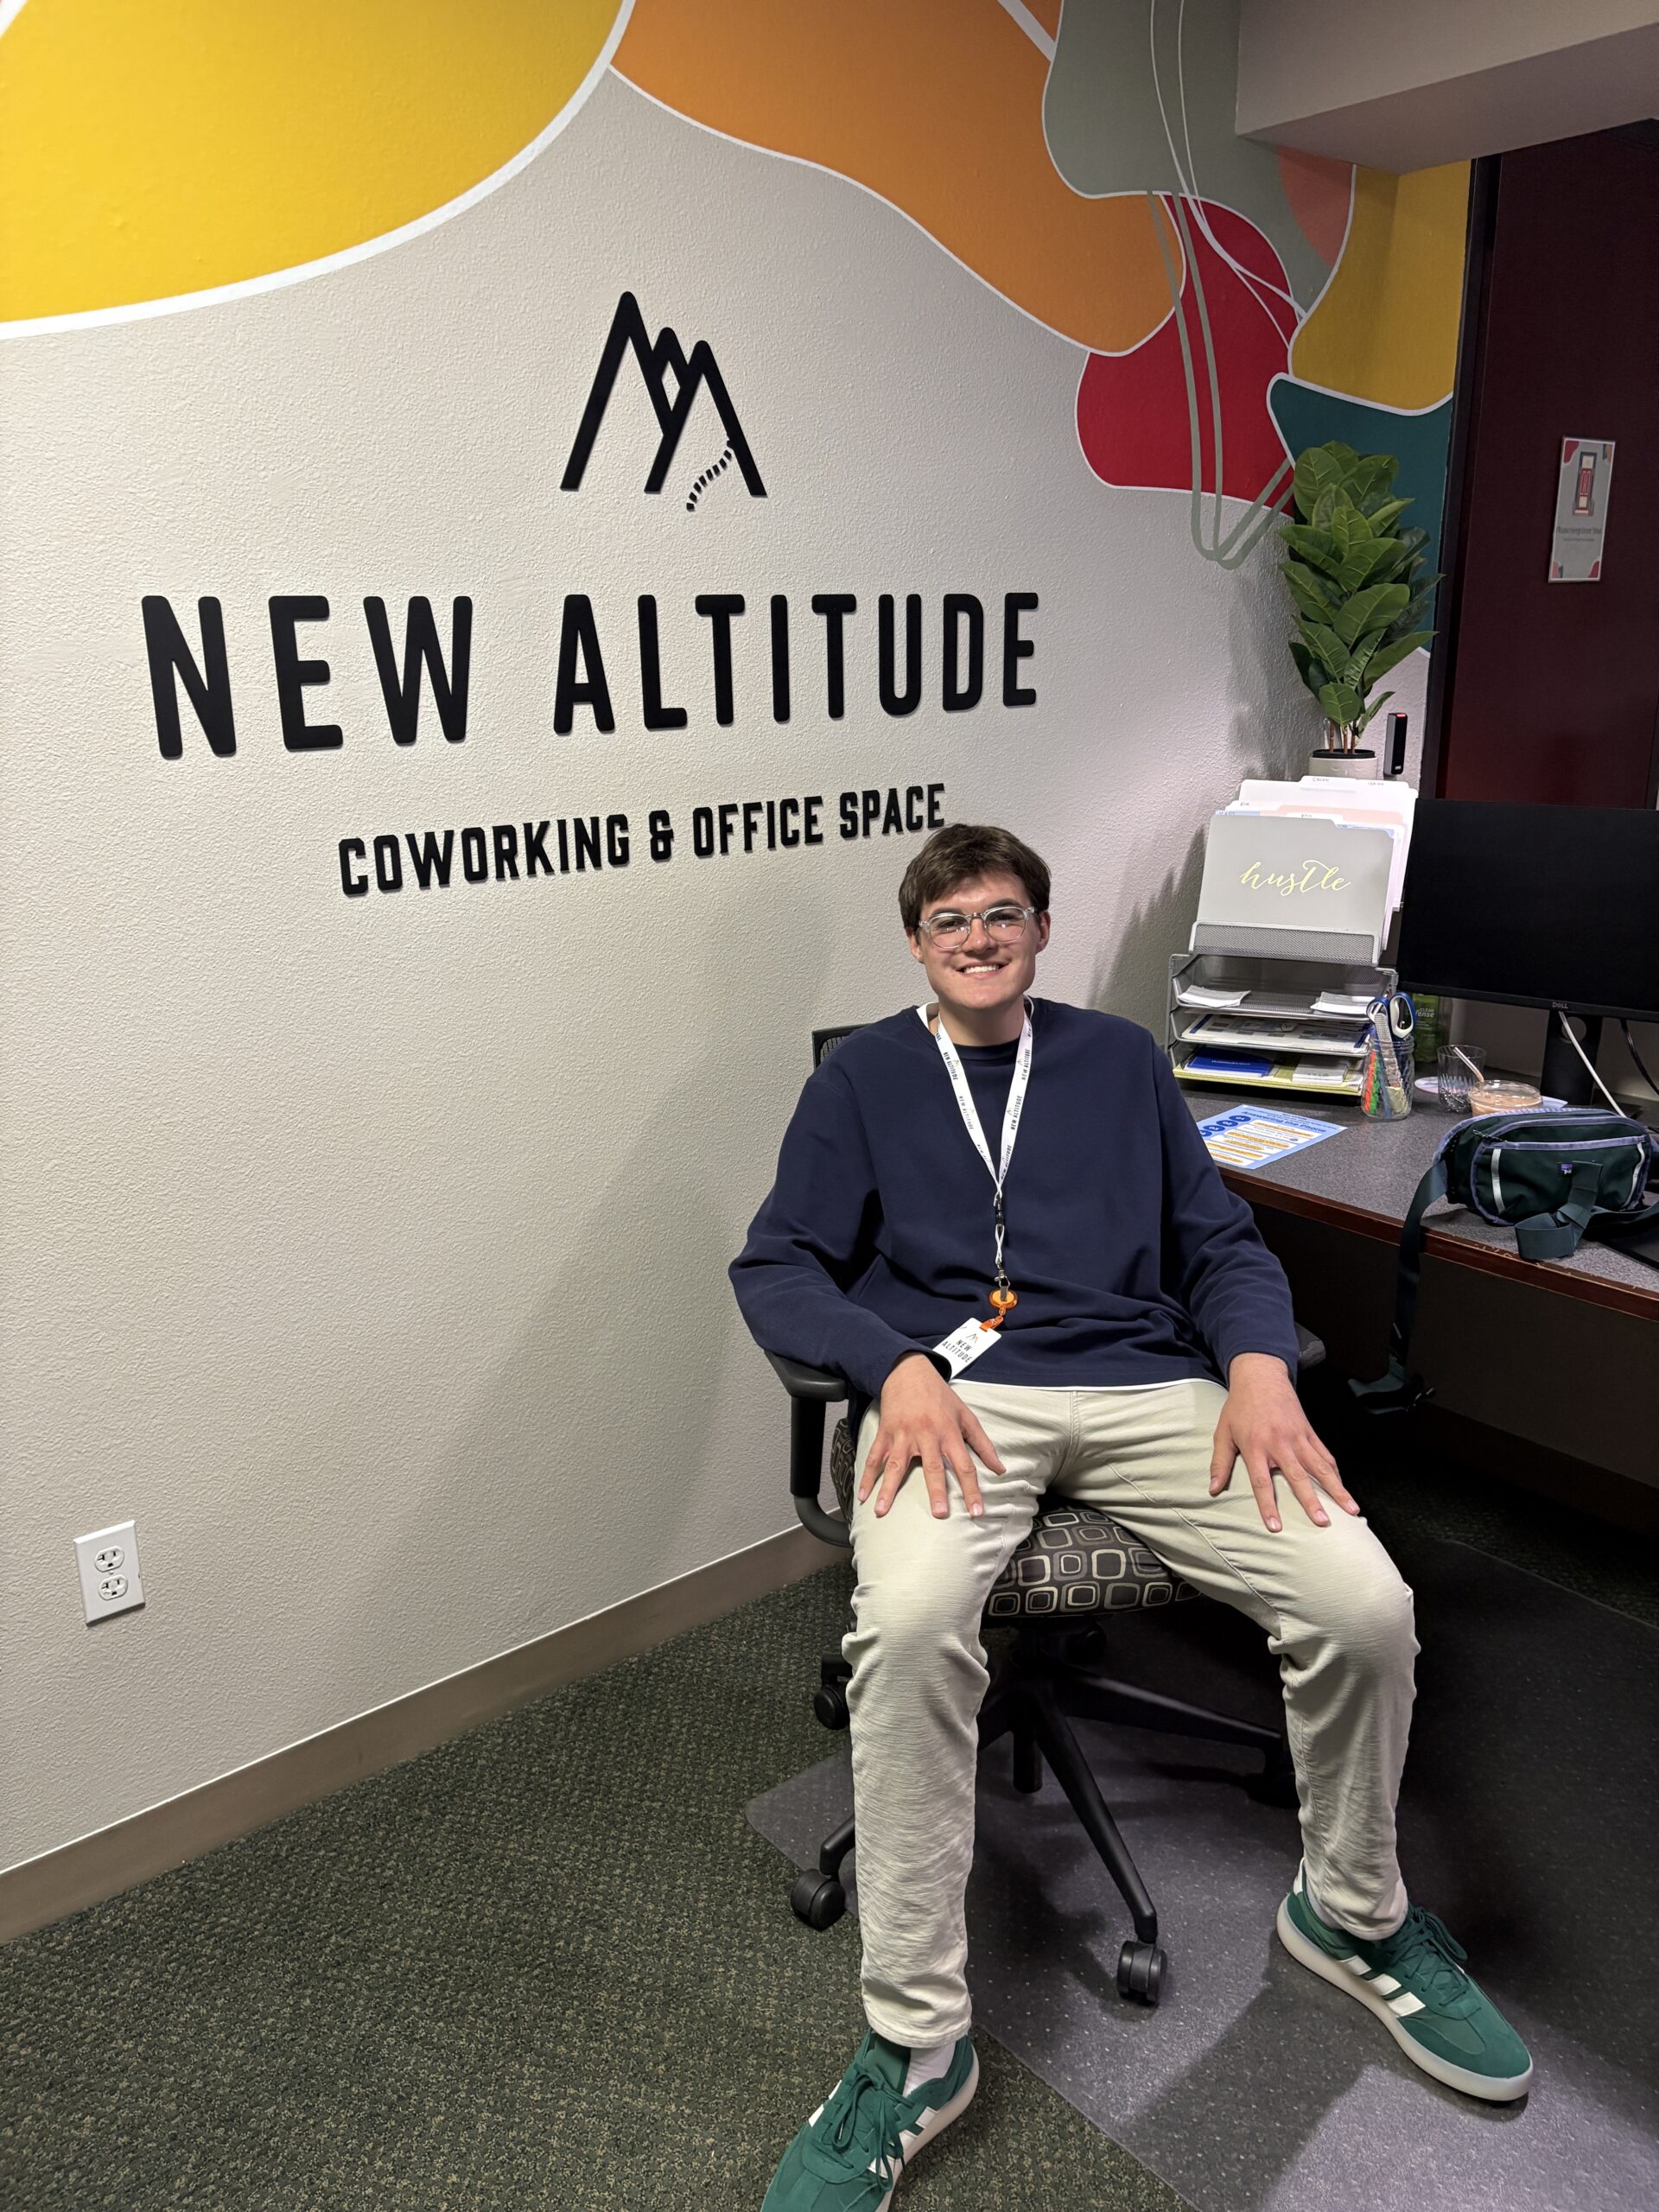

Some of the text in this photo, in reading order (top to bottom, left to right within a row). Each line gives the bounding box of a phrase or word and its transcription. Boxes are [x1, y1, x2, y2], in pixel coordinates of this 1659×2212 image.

[143, 593, 1039, 760] NEW ALTITUDE
[338, 783, 945, 896] COWORKING & OFFICE SPACE
[1239, 859, 1351, 896] hustle
[946, 1060, 958, 1080] ALTITUDE
[1013, 1095, 1023, 1118] ALTITUDE
[1241, 1110, 1285, 1124] Answering
[1300, 1123, 1327, 1133] Phone
[942, 1341, 973, 1363] ALTITUDE
[957, 1339, 973, 1351] NEW
